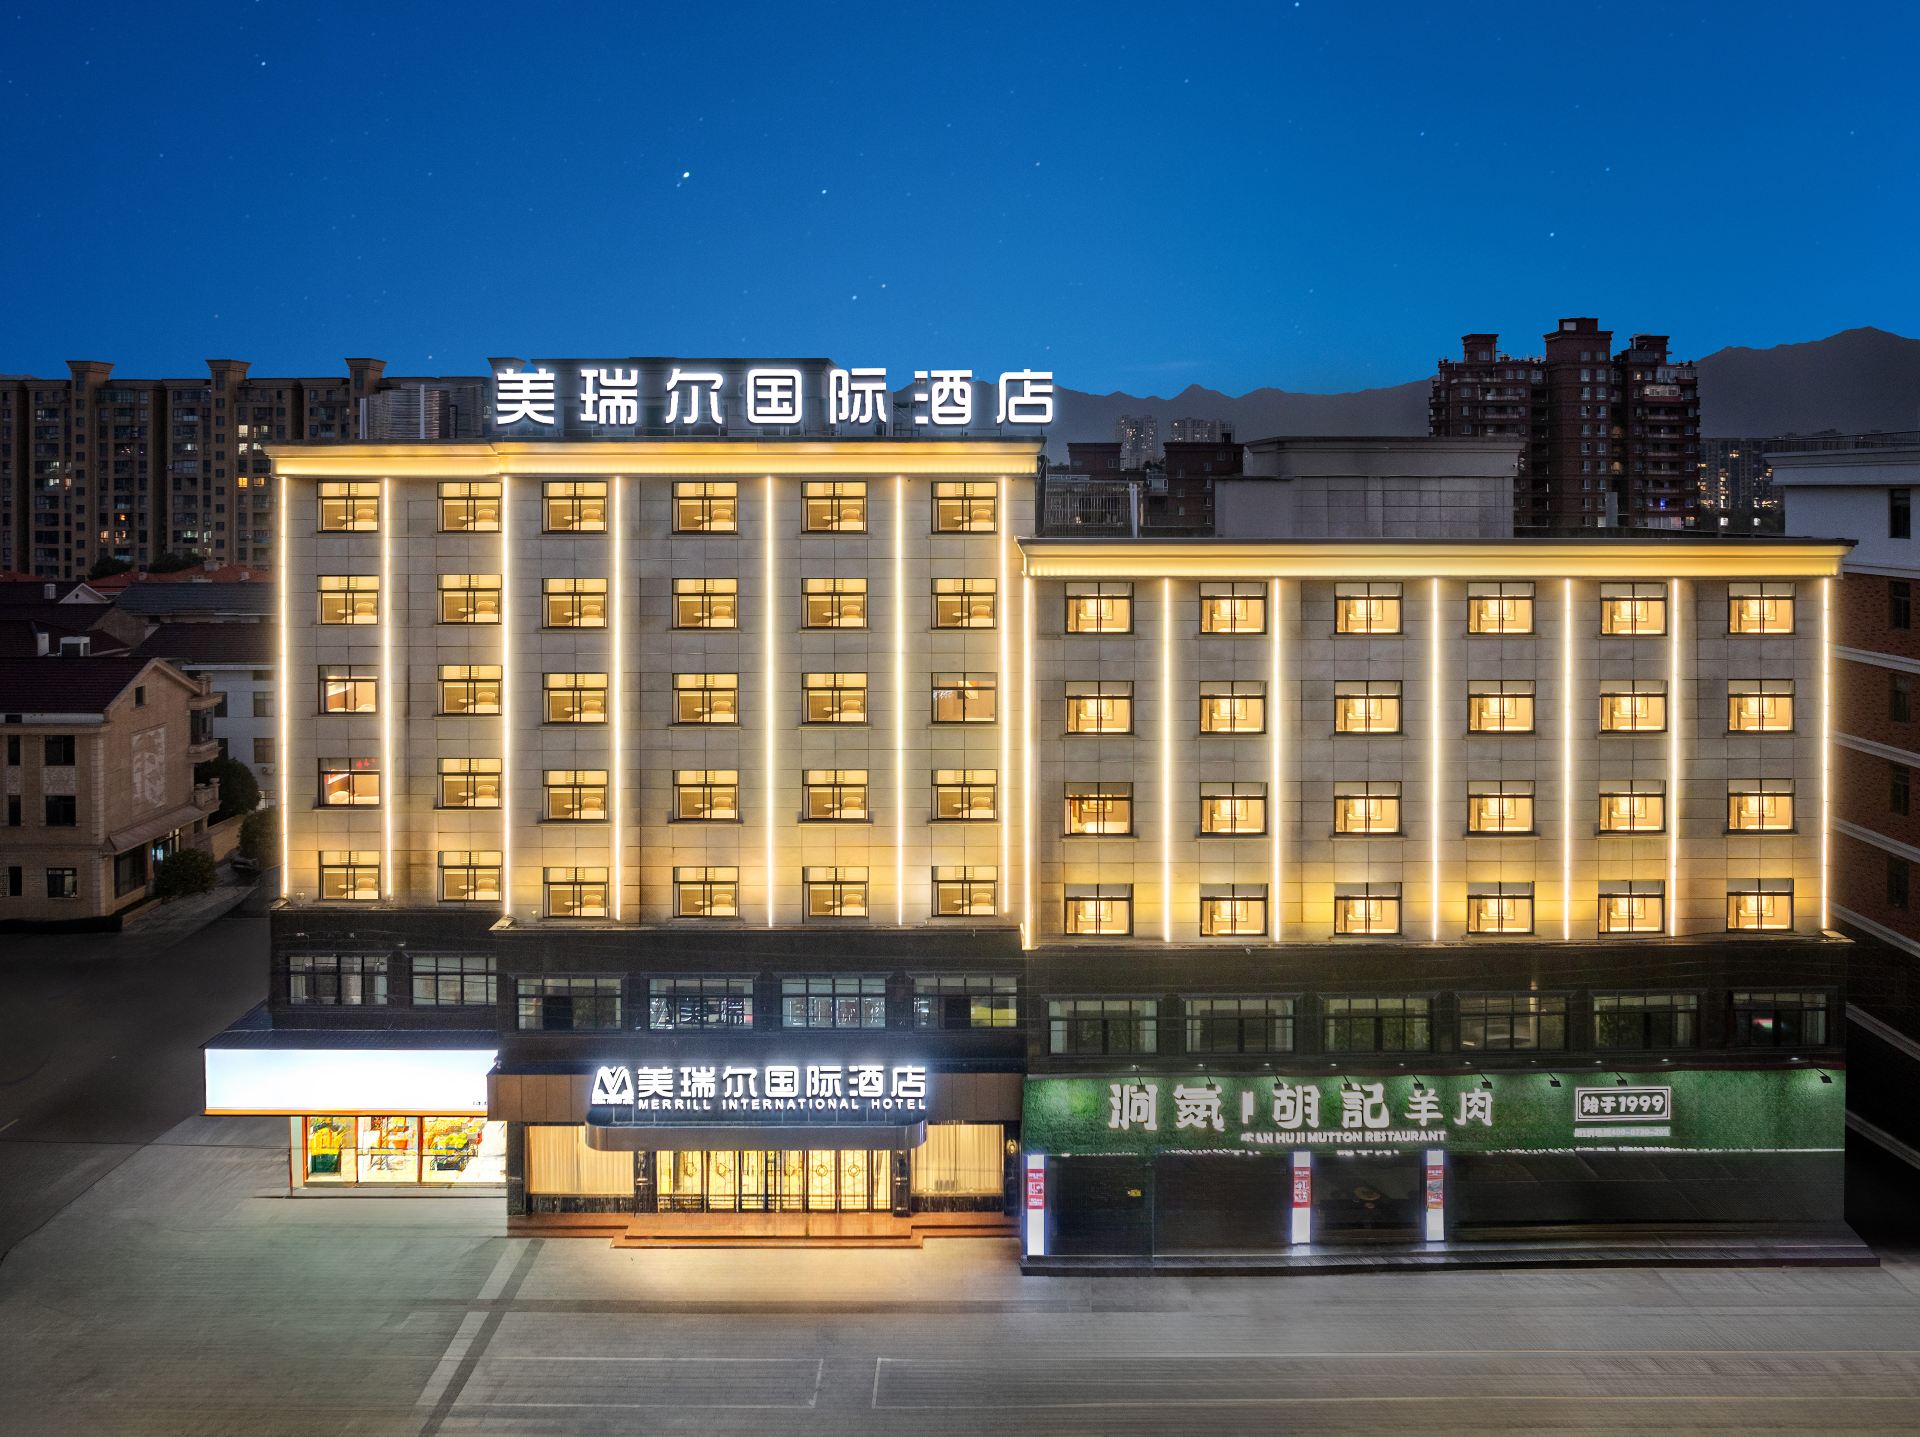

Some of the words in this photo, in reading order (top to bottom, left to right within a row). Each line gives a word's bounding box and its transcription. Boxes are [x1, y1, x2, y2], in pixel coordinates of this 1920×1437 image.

[497, 368, 1053, 424] 美瑞尔国际酒店
[638, 1066, 926, 1098] 美瑞尔国际酒店
[638, 1099, 711, 1111] MERRILL
[722, 1098, 860, 1110] INTERNATIONAL
[871, 1098, 926, 1110] HOTEL
[1307, 1131, 1363, 1143] MUTTON
[1364, 1130, 1447, 1143] RESTAURANT
